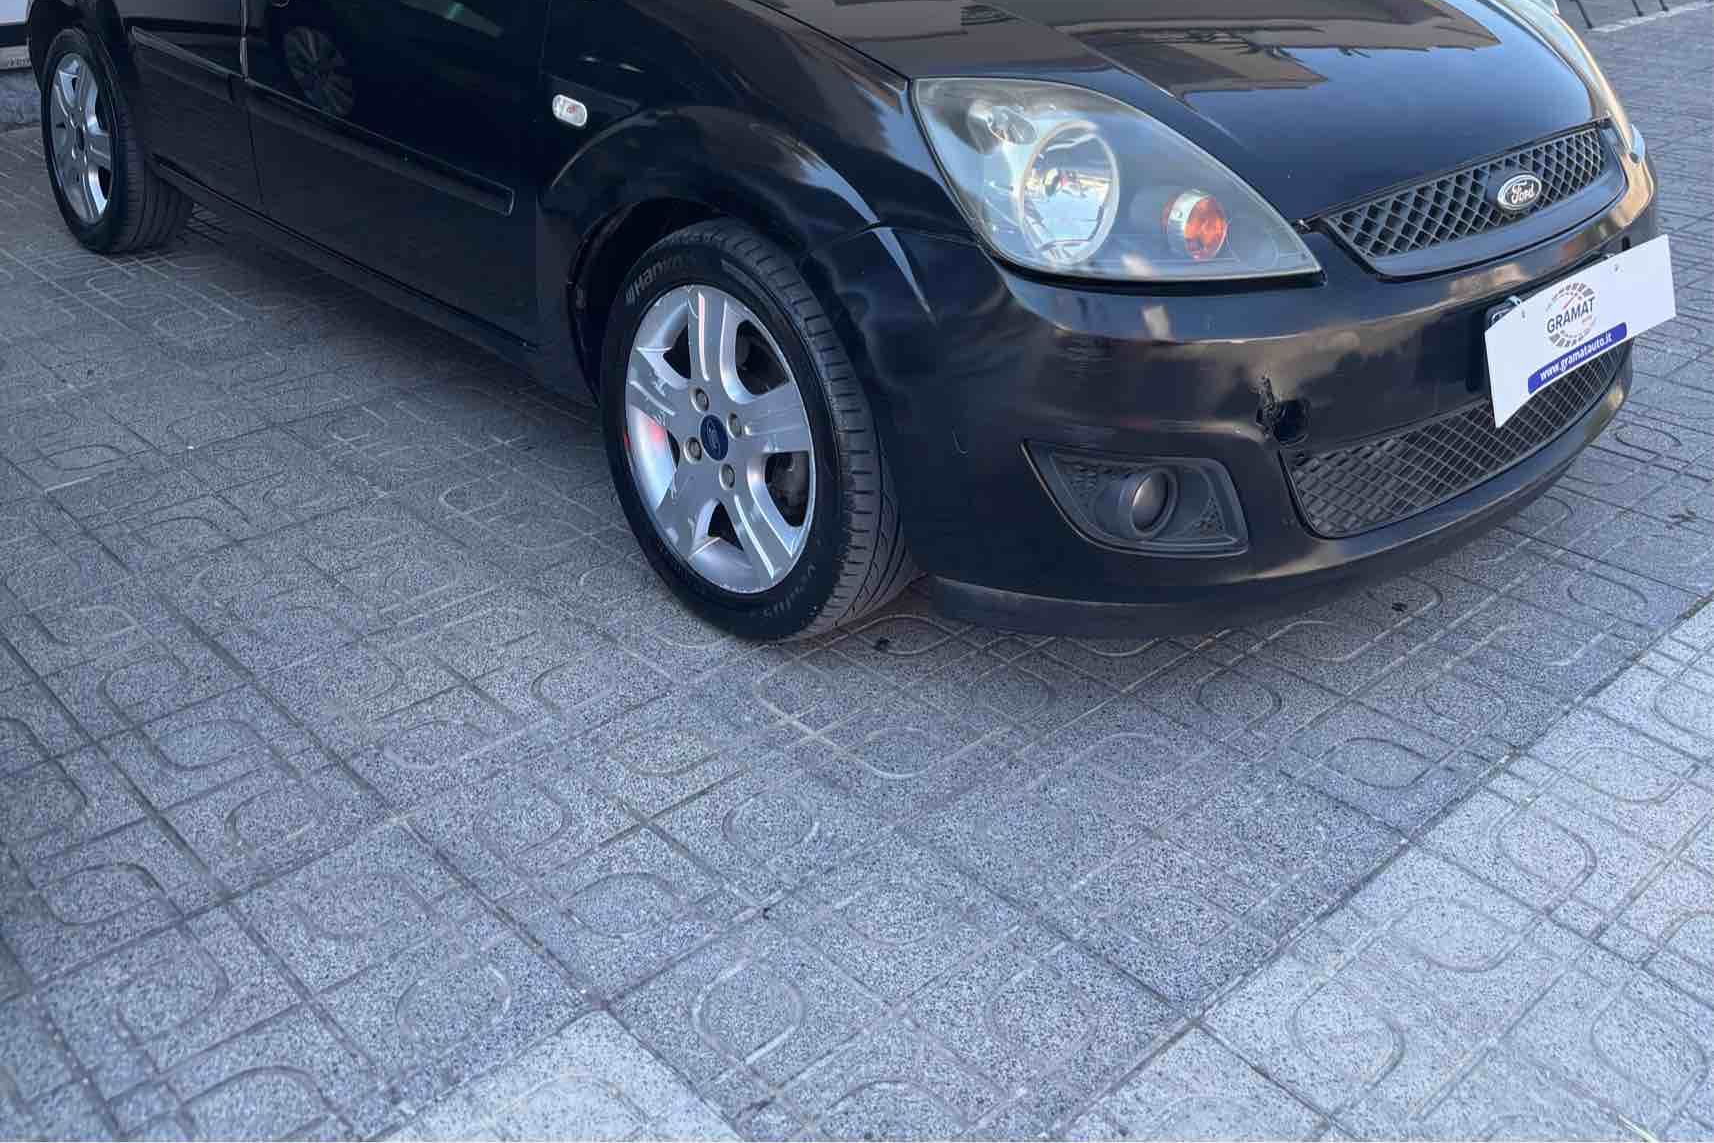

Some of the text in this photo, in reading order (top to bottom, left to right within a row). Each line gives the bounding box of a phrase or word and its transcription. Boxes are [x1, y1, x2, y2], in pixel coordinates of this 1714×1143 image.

[1505, 180, 1535, 204] Ford
[1547, 297, 1595, 333] GRAMAT
[1540, 332, 1613, 382] www.gramatauto.it
